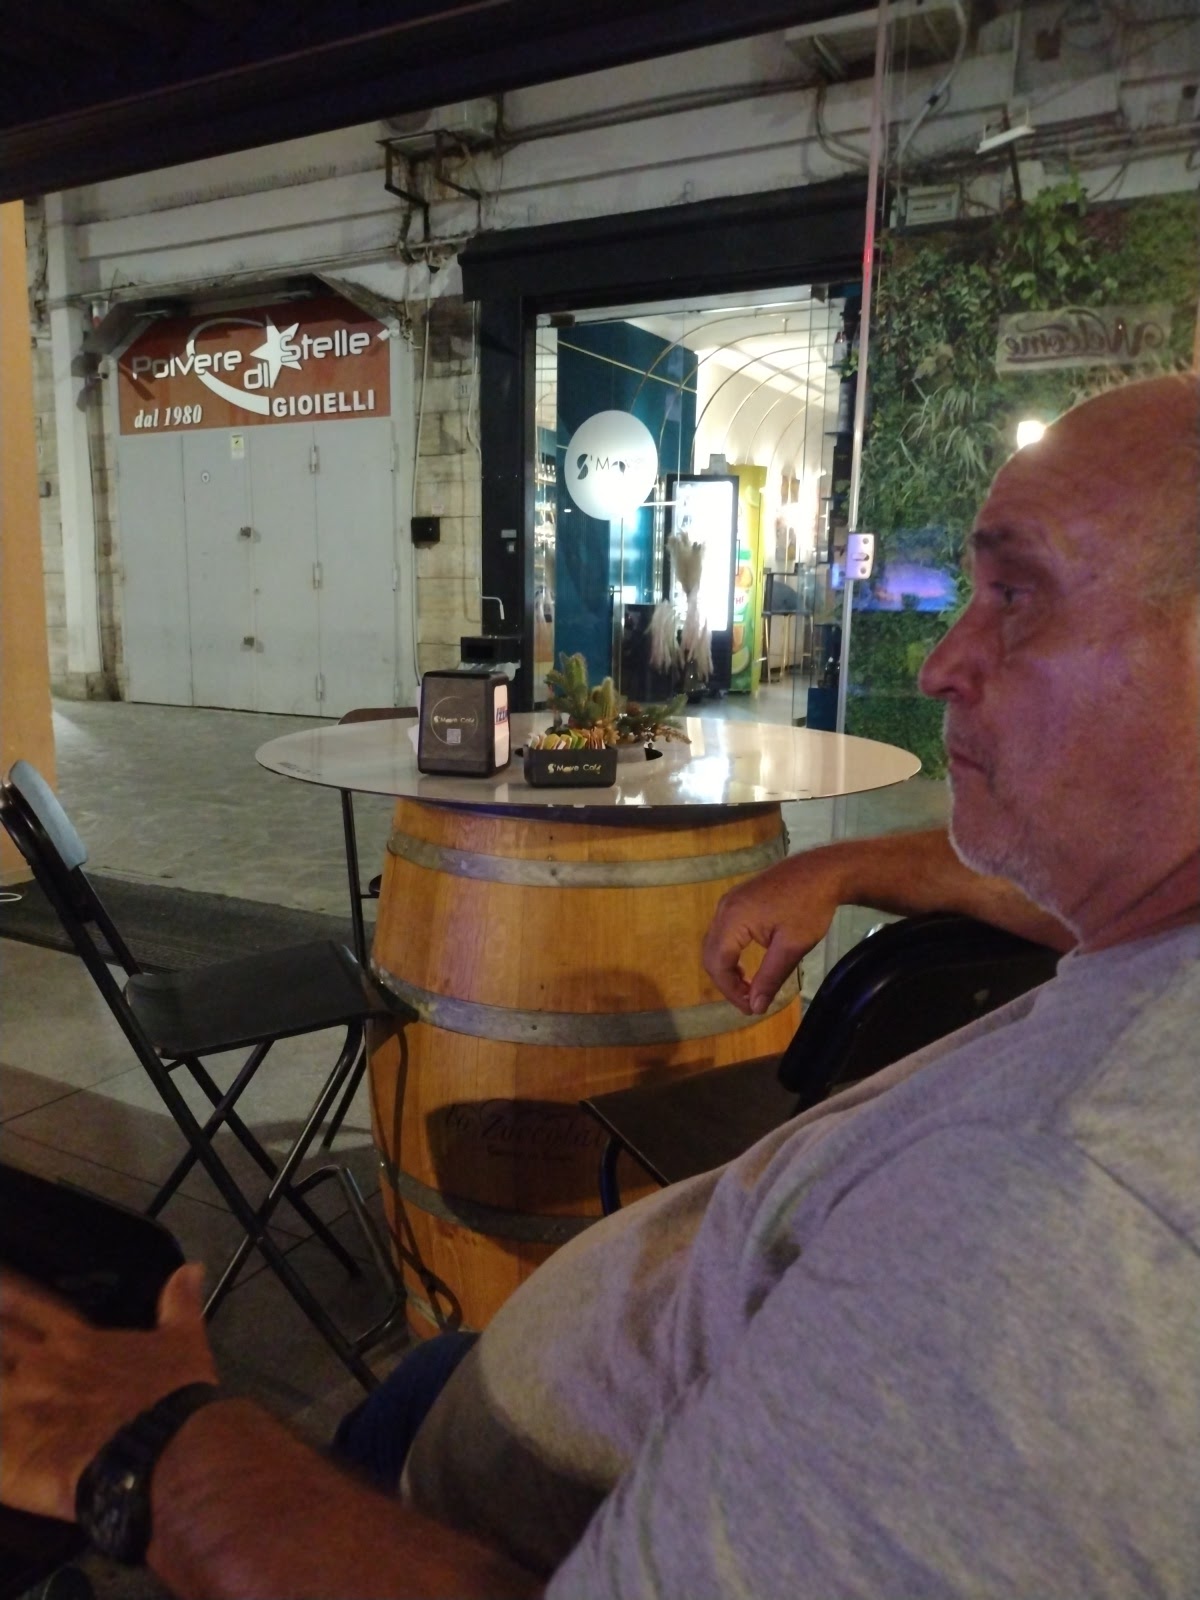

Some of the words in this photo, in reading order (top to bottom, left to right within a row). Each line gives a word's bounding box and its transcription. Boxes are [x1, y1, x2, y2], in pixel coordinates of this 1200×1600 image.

[132, 350, 242, 380] Polvere
[280, 329, 370, 363] Stelle
[134, 408, 159, 428] dal
[163, 404, 203, 426] 1980
[272, 389, 375, 417] GIOIELLI
